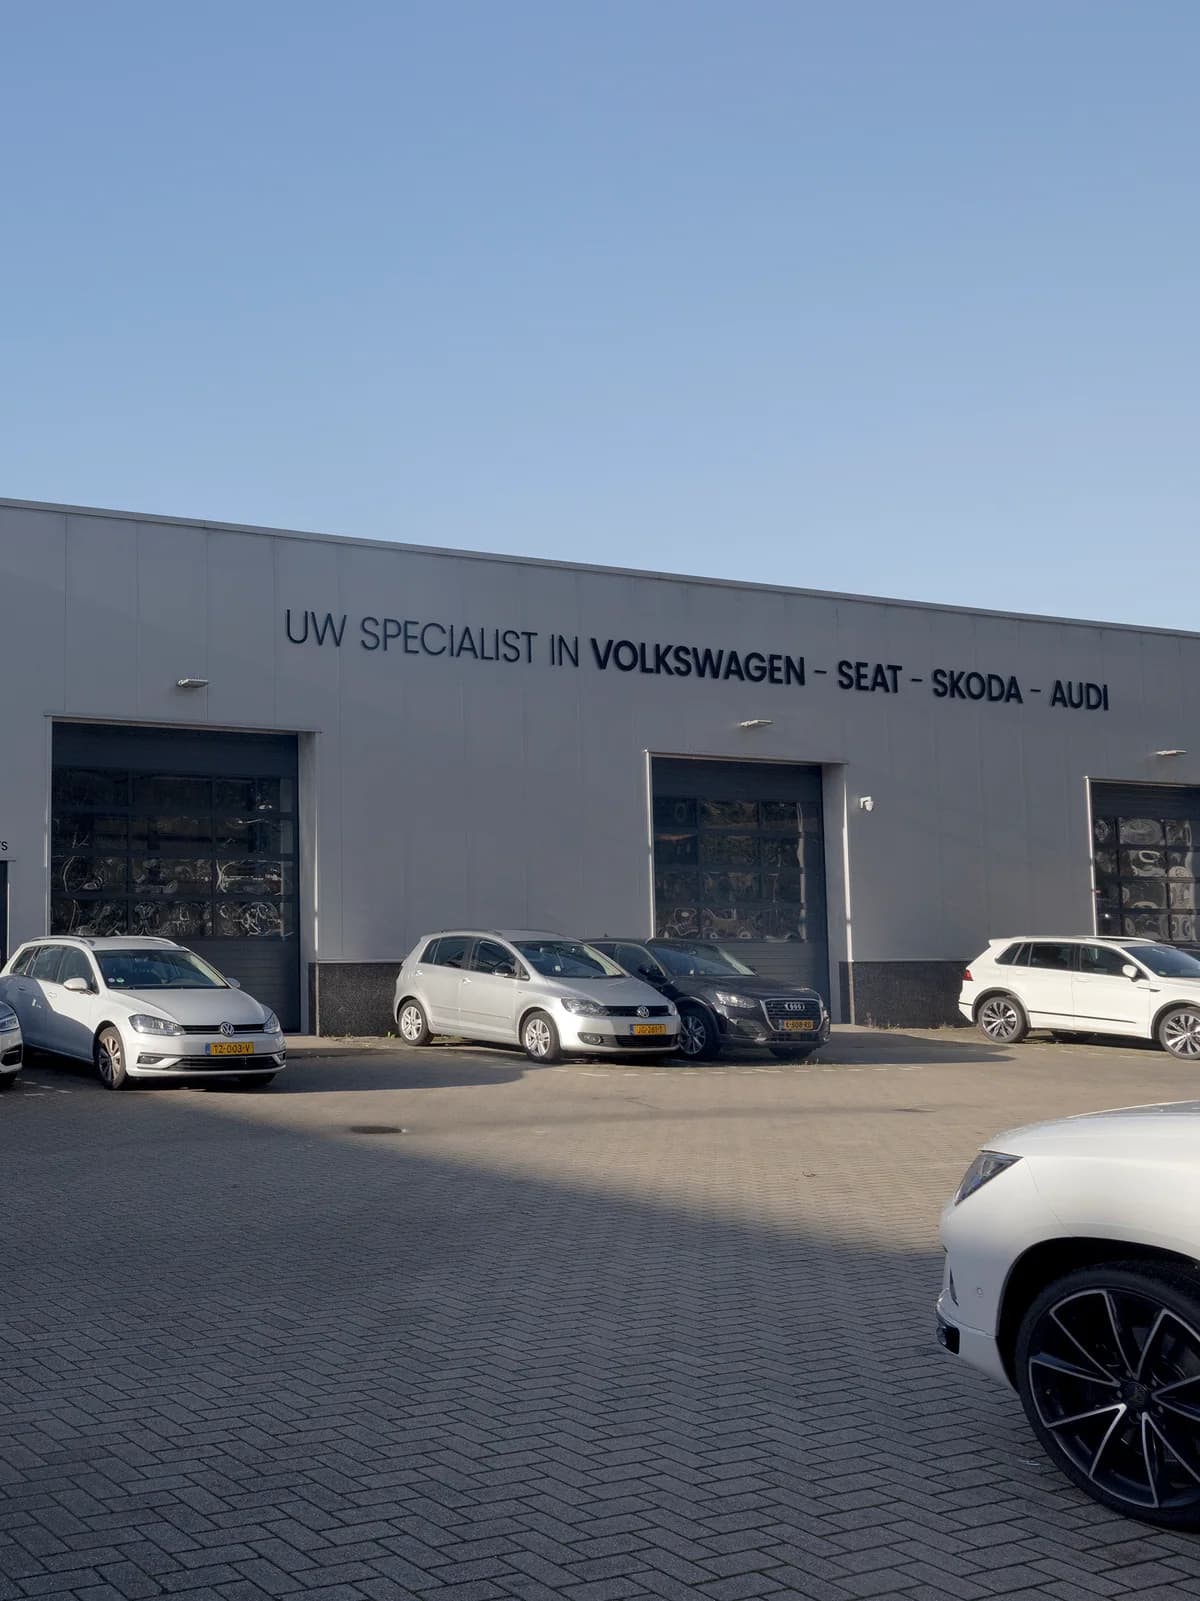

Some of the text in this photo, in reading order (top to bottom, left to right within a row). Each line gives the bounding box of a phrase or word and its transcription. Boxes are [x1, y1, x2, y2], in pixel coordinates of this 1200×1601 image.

[286, 609, 347, 647] UW
[360, 617, 538, 663] SPECIALIST
[550, 633, 579, 667] IN
[591, 638, 806, 686] VOLKSWAGEN
[838, 660, 903, 694] SEAT
[933, 669, 1023, 703] SKODA
[1051, 679, 1109, 711] AUDI
